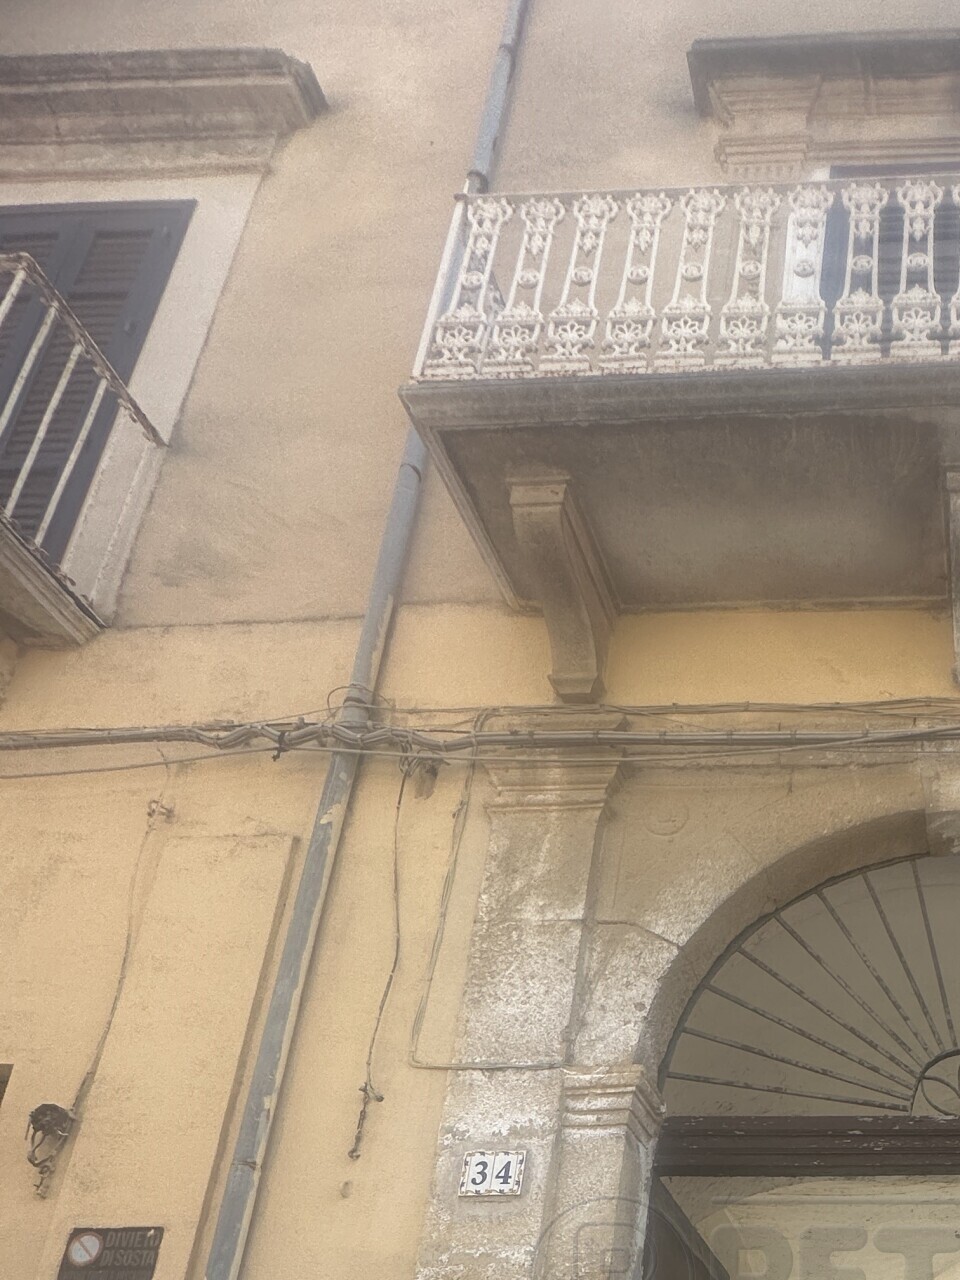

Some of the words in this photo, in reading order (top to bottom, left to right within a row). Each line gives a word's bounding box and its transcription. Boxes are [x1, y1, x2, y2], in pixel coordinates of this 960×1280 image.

[471, 1160, 512, 1185] 34
[104, 1230, 161, 1248] DIVIETO
[113, 1249, 156, 1267] SOSTA
